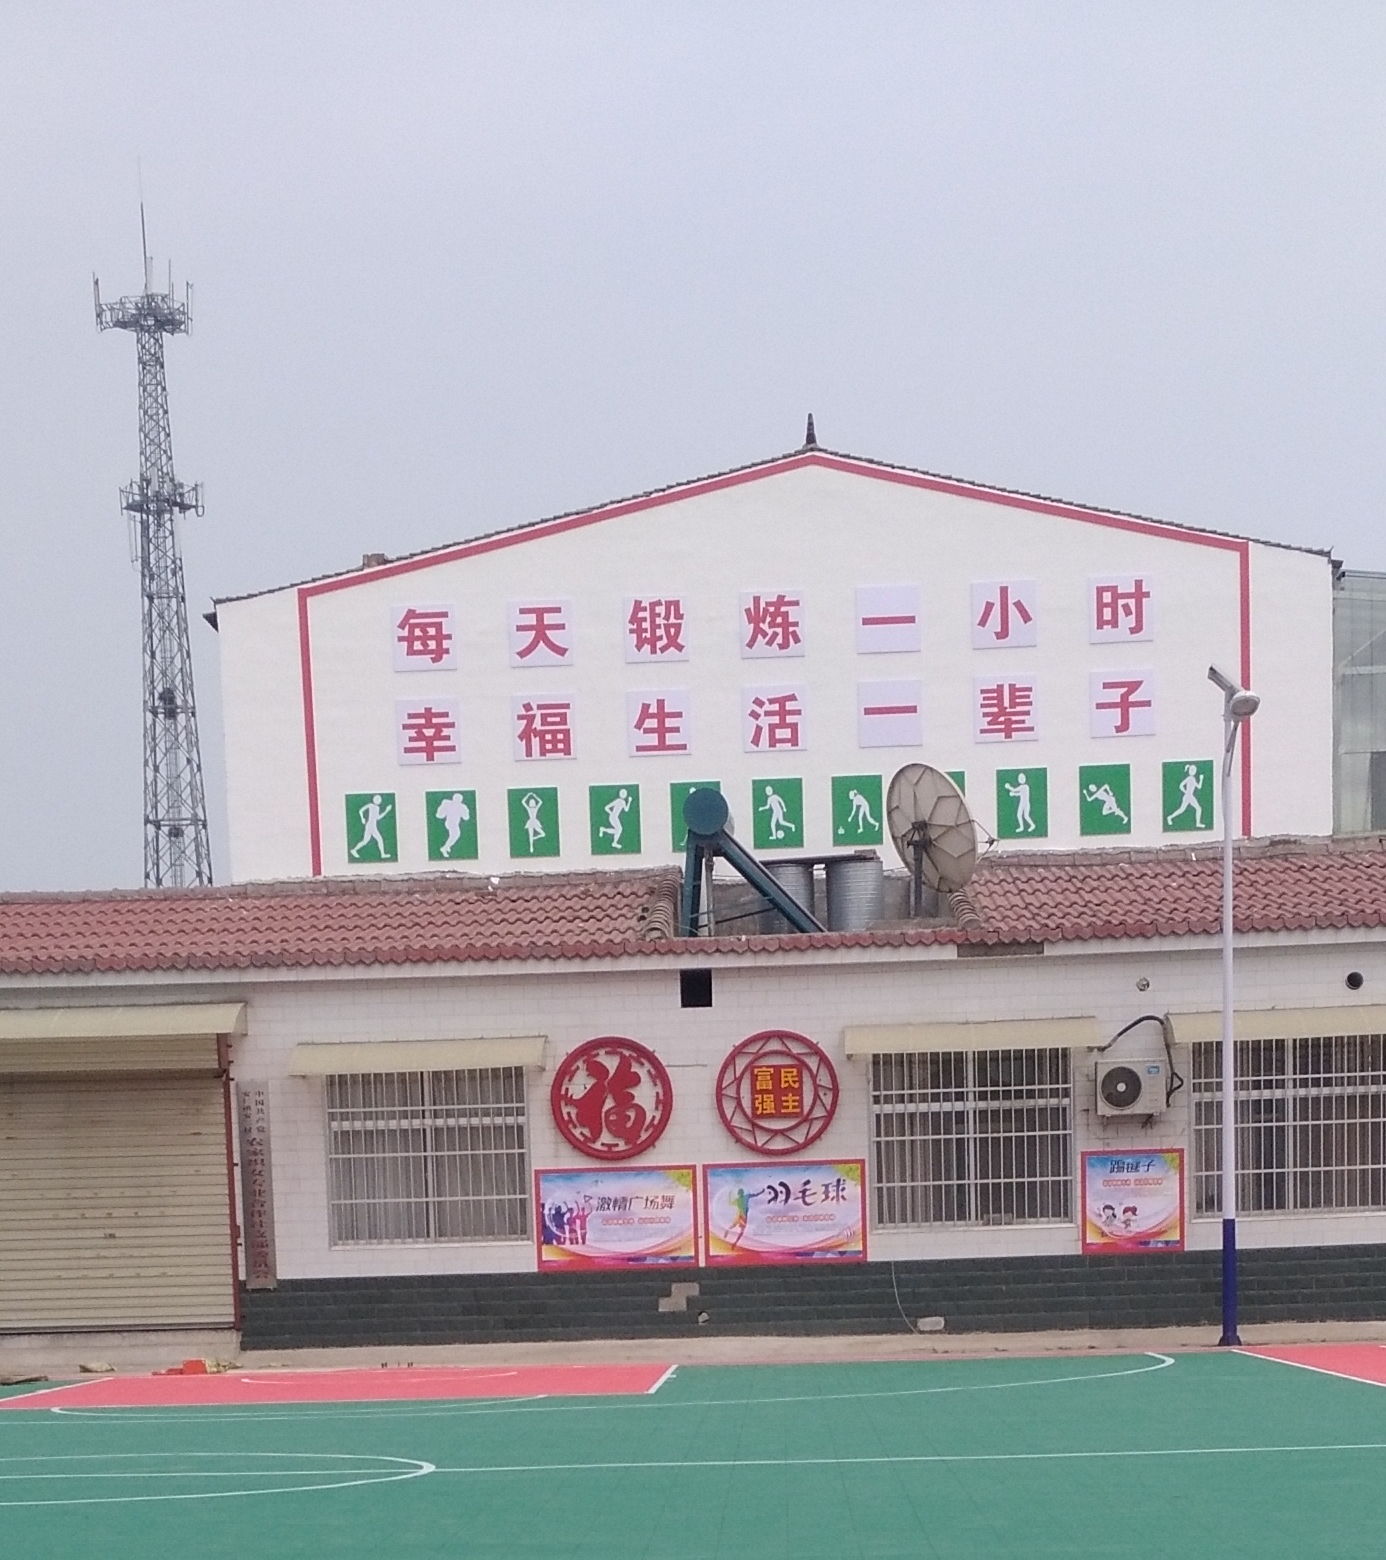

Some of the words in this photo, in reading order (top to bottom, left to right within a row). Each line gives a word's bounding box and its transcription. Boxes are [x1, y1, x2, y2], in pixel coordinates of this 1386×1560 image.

[397, 580, 1151, 664] 每天锻炼一小时
[402, 679, 1152, 762] 幸福生活一辈子
[754, 1066, 776, 1115] 富强
[779, 1066, 801, 1114] 民主
[1109, 1159, 1156, 1174] 踢毽子
[595, 1194, 676, 1212] 激情广场舞
[766, 1177, 847, 1207] 羽毛球
